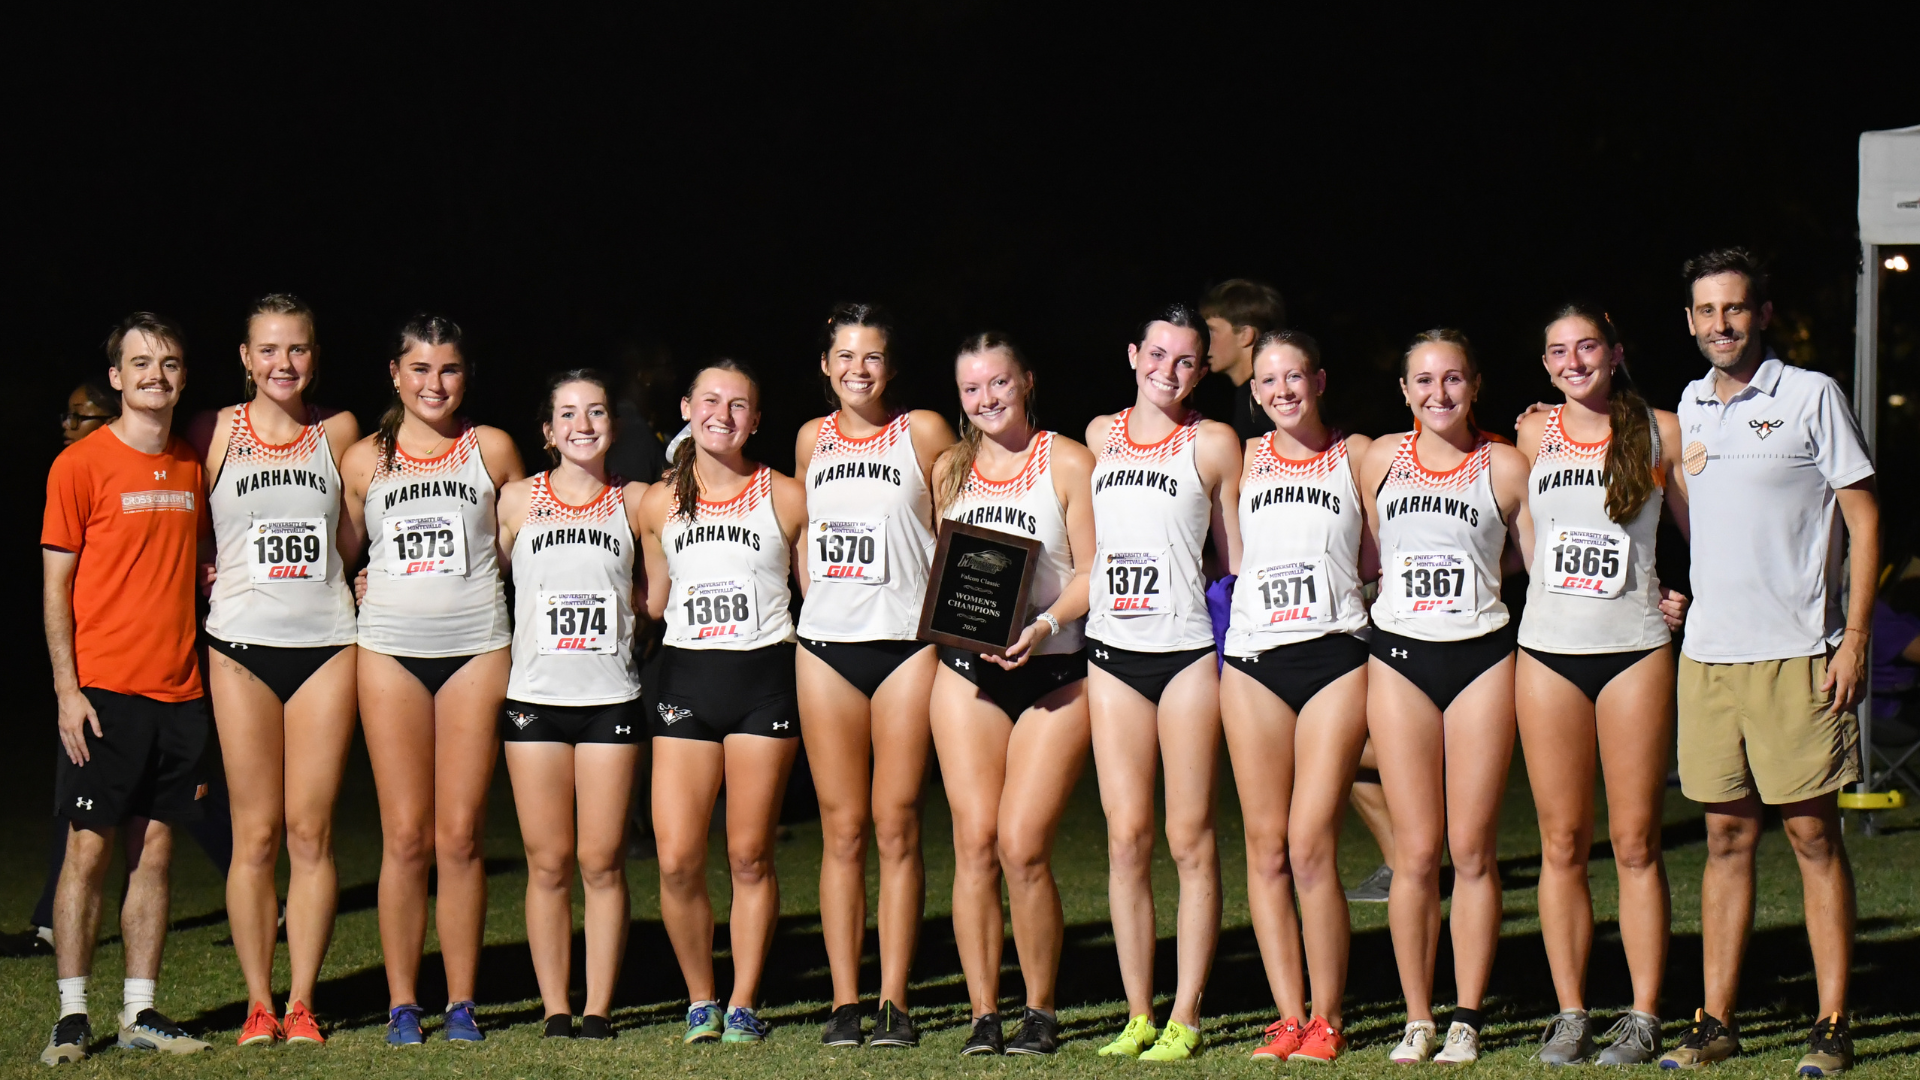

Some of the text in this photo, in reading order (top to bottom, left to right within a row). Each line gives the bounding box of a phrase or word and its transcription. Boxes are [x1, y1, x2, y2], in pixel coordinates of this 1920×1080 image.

[236, 469, 327, 497] WARHAWKS
[814, 462, 900, 489] WARHAWKS
[1095, 470, 1177, 497] WARHAWKS
[122, 495, 152, 505] CROSS
[384, 481, 477, 510] WARHAWKS
[1251, 486, 1340, 515] WARHAWKS
[1386, 496, 1478, 528] WARHAWKS
[254, 535, 320, 564] 1369
[393, 529, 454, 560] 1373
[532, 528, 620, 557] WARHAWKS
[674, 525, 760, 554] WARHAWKS
[816, 534, 875, 564] 1370
[269, 565, 308, 578] GILL
[827, 565, 865, 577] GILL
[1552, 544, 1619, 578] 1365
[960, 573, 1001, 588] Falcon Classic
[1106, 566, 1159, 595] 1372
[1258, 575, 1317, 610] 1371
[1401, 568, 1465, 598] 1367
[1562, 576, 1604, 591] GILL
[683, 593, 749, 626] 1368
[947, 599, 1001, 618] CHAMPIONS
[955, 592, 997, 608] WOMEN'S
[1113, 597, 1151, 609] GILL
[546, 608, 607, 635] 1374
[1270, 607, 1311, 623] GILL
[698, 625, 737, 638] GILL
